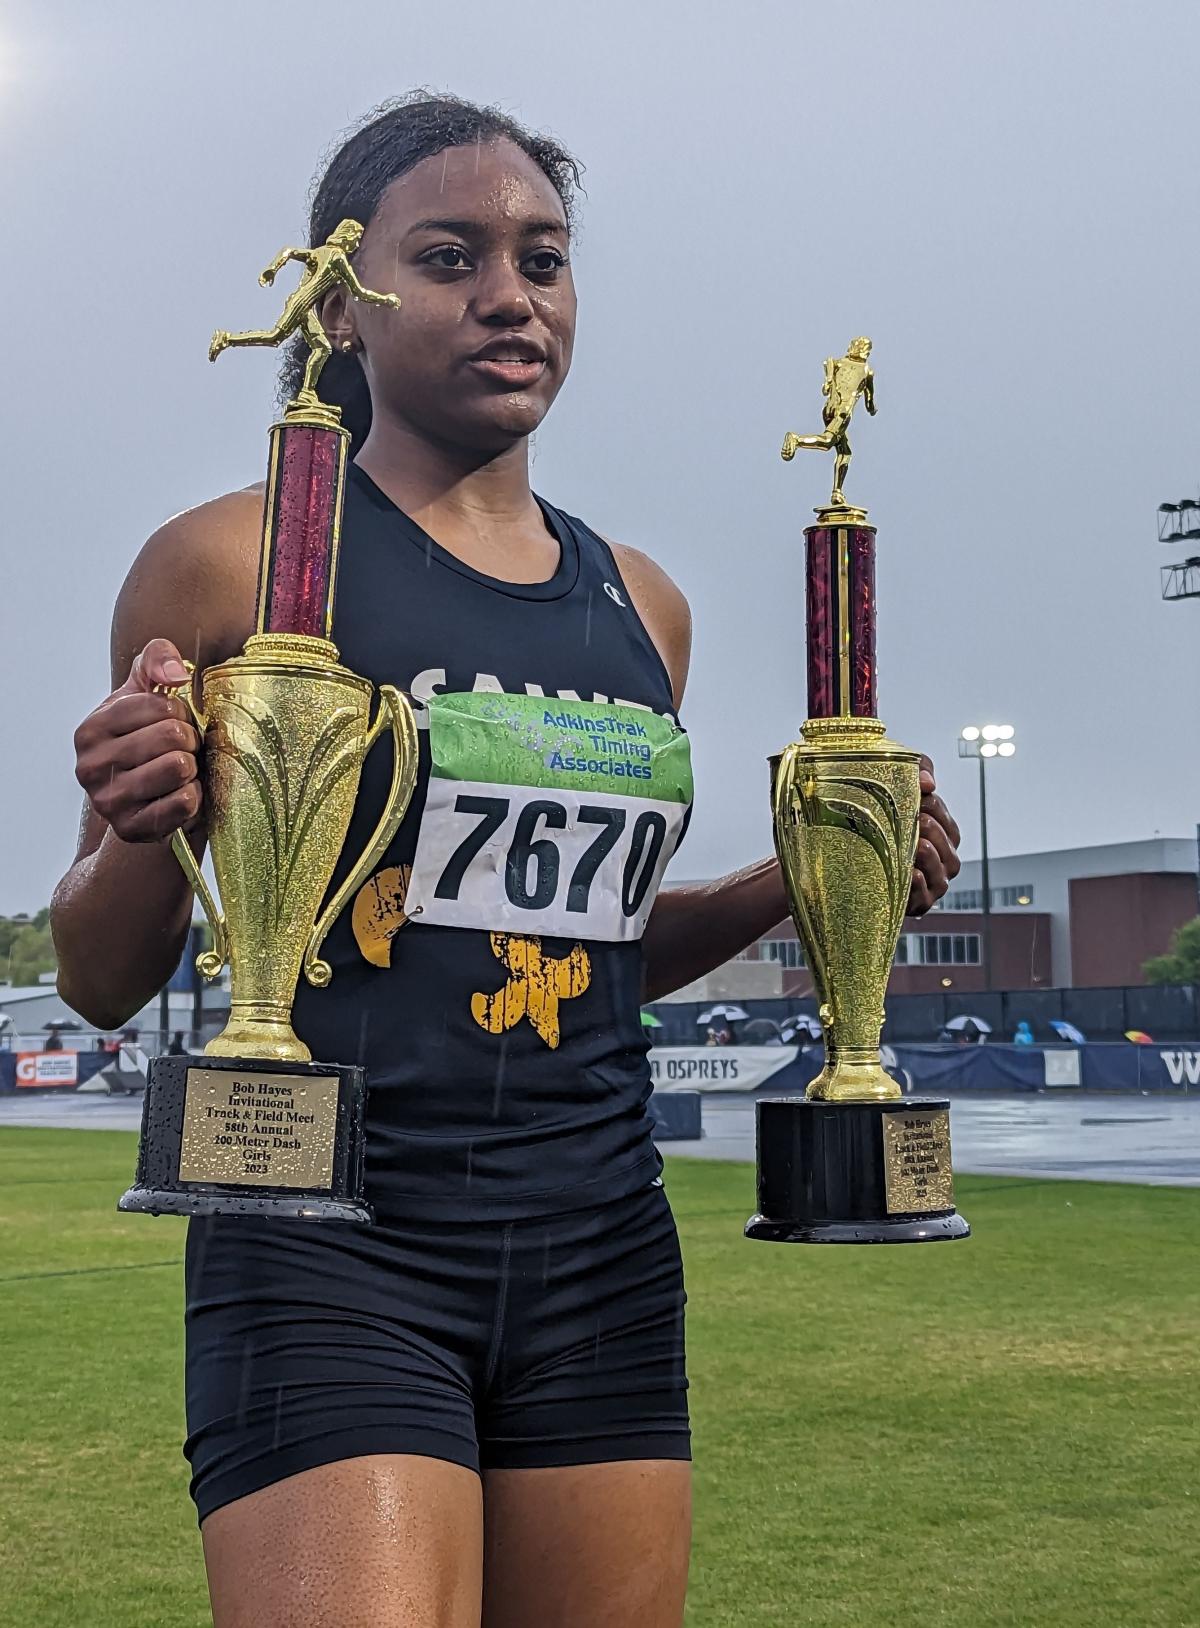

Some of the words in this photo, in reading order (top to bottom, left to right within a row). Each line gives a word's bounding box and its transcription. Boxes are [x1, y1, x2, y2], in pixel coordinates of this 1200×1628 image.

[588, 734, 651, 762] Timing
[550, 751, 652, 780] Associates
[433, 794, 667, 918] 7670
[16, 1058, 35, 1080] G
[667, 1059, 738, 1079] OSPREYS
[232, 1082, 255, 1094] Bob
[258, 1083, 292, 1097] Hayes
[228, 1095, 294, 1109] Invitational
[206, 1107, 240, 1119] Track
[243, 1111, 251, 1120] &
[255, 1110, 283, 1122] Field
[286, 1112, 315, 1124] Meet
[225, 1122, 248, 1133] 58th
[251, 1124, 294, 1136] Annual
[215, 1135, 232, 1145] 200
[235, 1136, 270, 1148] Meter
[273, 1138, 301, 1150] Dash
[242, 1149, 272, 1161] Girls
[244, 1164, 268, 1174] 2023
